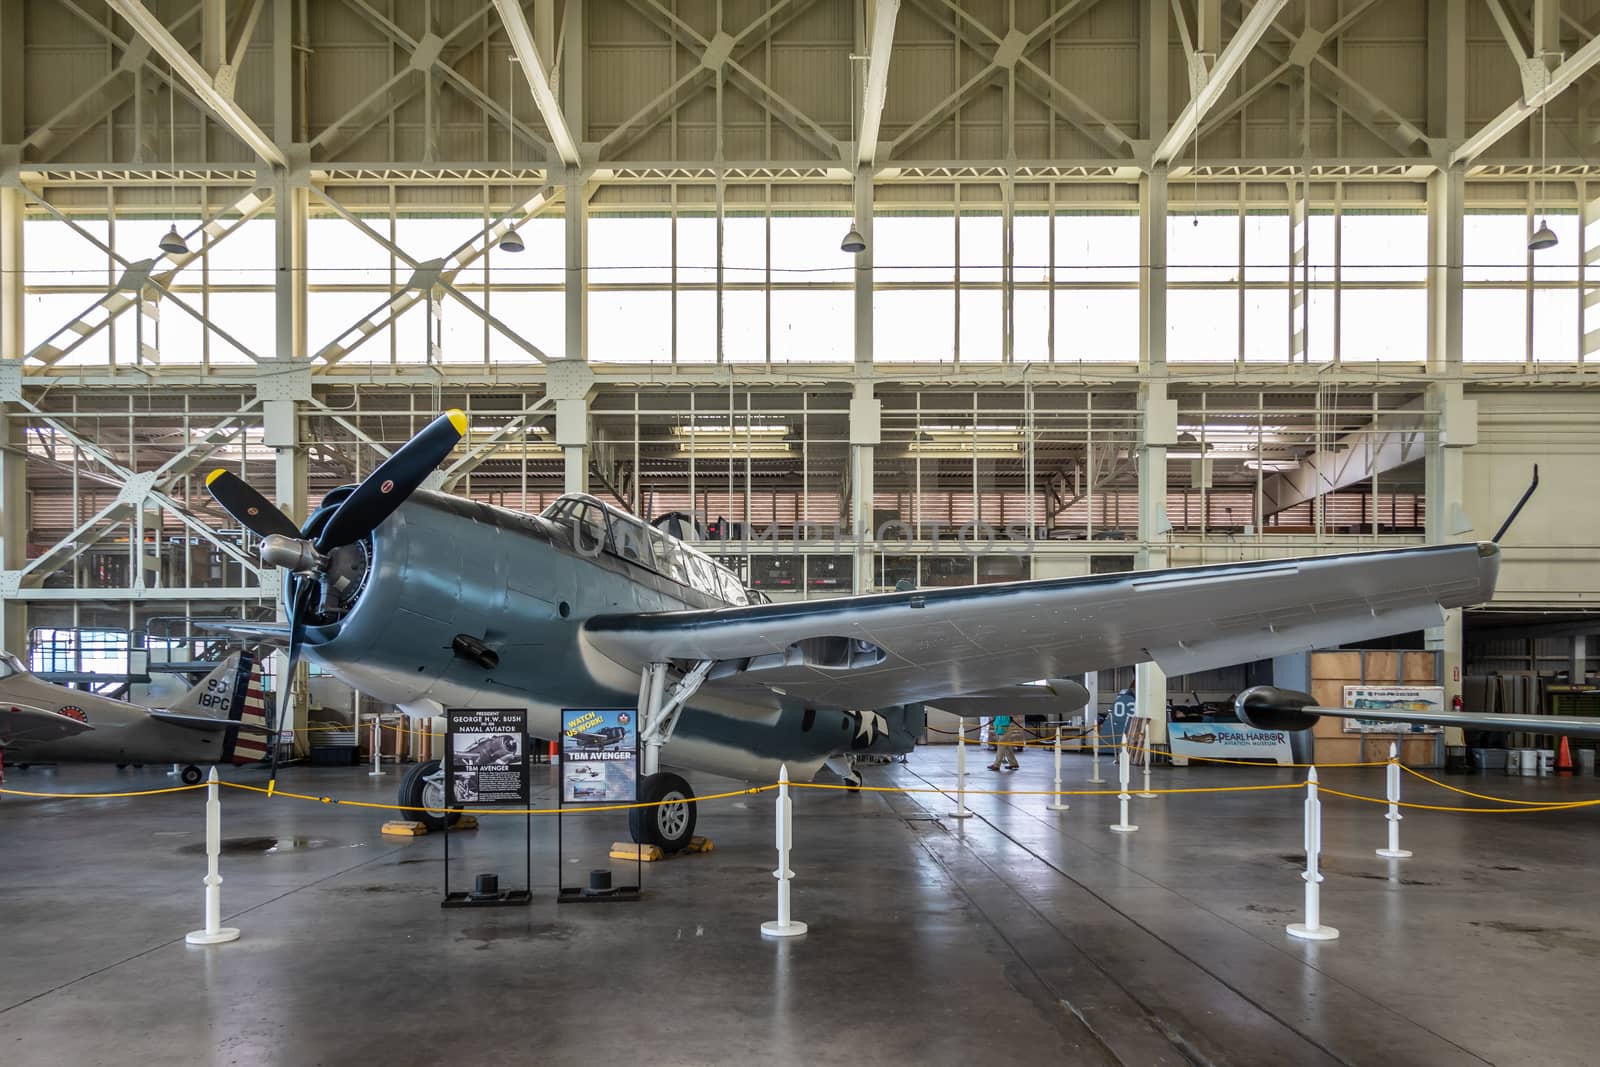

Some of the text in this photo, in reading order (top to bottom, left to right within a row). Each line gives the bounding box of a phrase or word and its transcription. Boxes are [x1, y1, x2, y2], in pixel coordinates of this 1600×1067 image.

[198, 692, 230, 711] 18PG
[1114, 701, 1137, 717] 03
[566, 715, 605, 737] US WORK!
[567, 711, 596, 727] WATCH
[1217, 732, 1286, 744] PEARL HARBOR
[568, 751, 631, 760] TBM AVENGER
